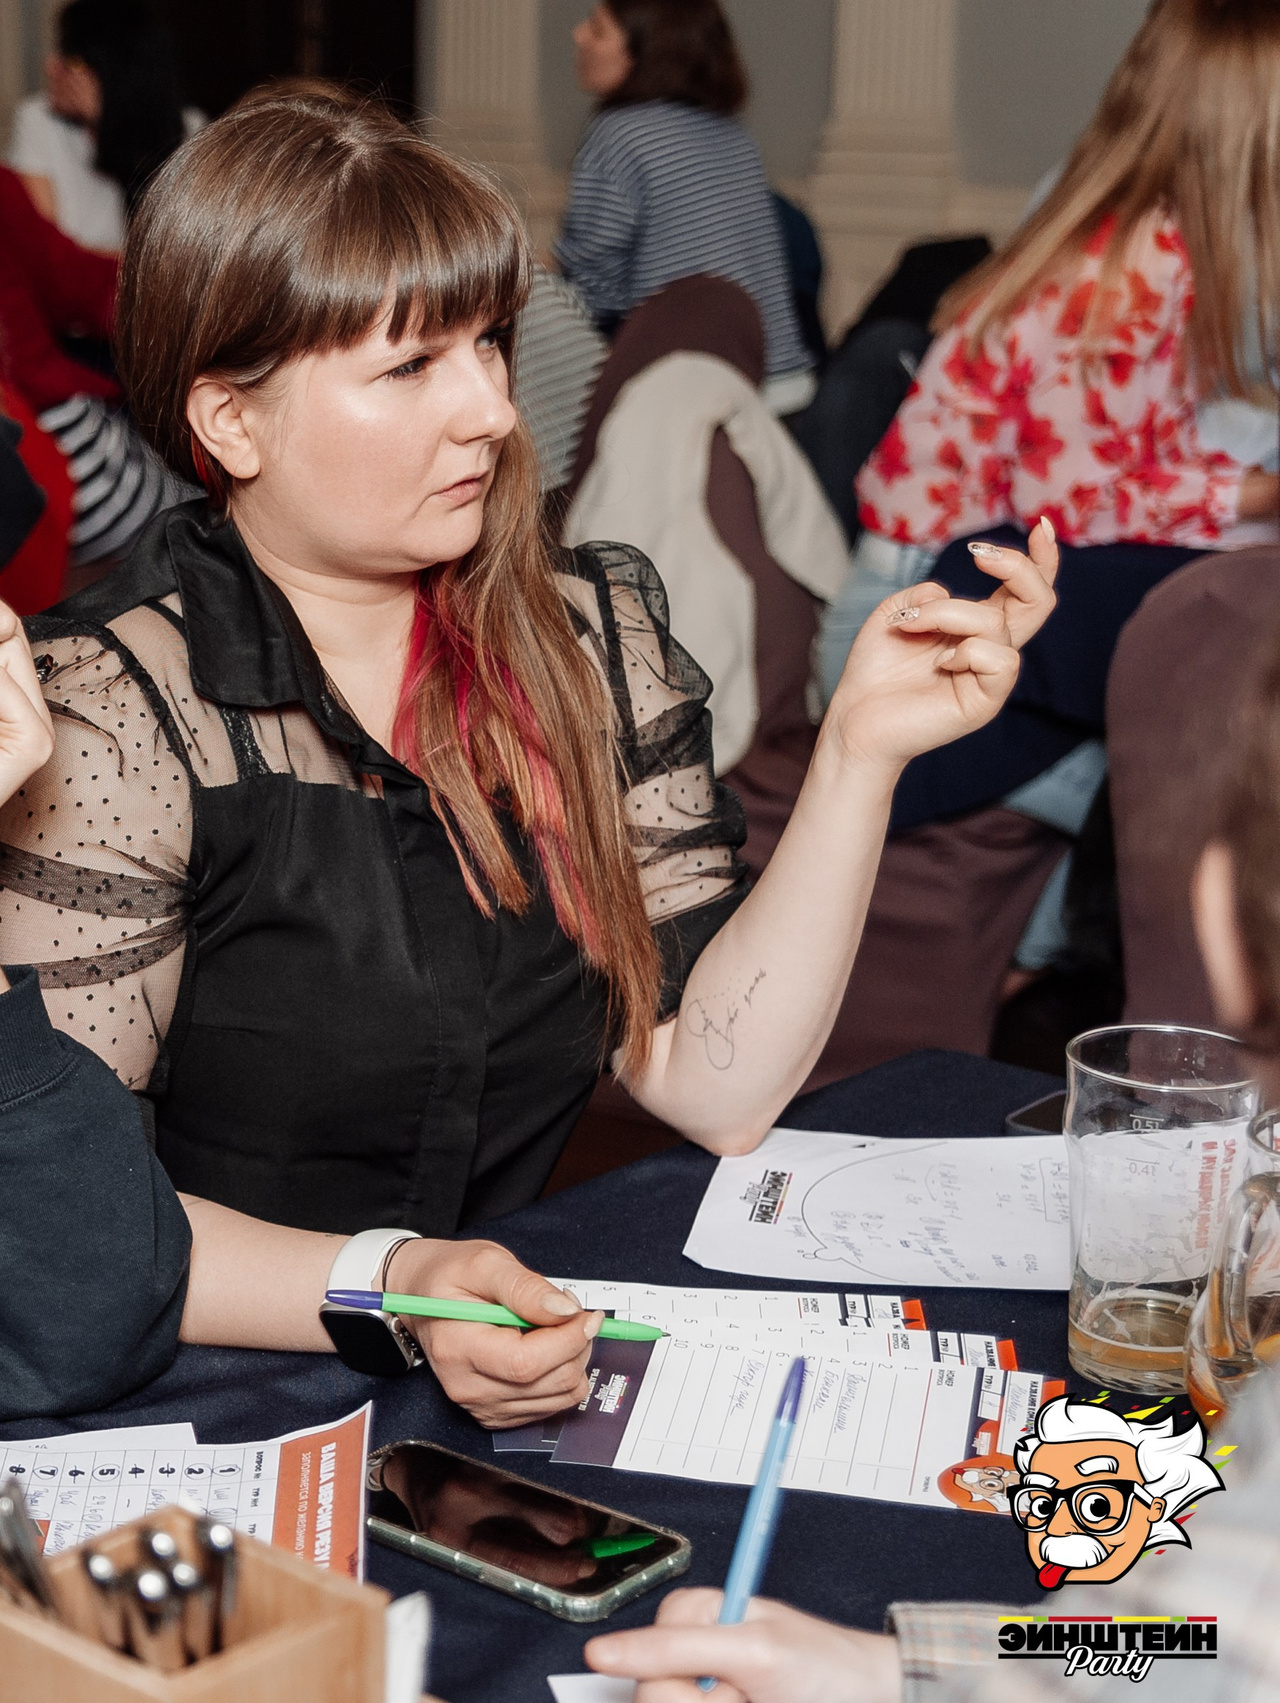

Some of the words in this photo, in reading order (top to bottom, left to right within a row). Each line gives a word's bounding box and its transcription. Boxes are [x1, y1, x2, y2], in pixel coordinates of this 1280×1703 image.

[810, 1298, 820, 1313] НОМЕР
[673, 1339, 689, 1349] 10
[900, 1333, 910, 1350] НОМЕР
[940, 1338, 949, 1348] ТУР
[936, 1369, 945, 1386] ВОПРОСА
[944, 1370, 956, 1387] НОМЕР
[984, 1374, 993, 1385] ТУР
[1028, 1381, 1039, 1407] НАЗВАНИЕ
[255, 1451, 264, 1472] ВОПРОС
[319, 1441, 337, 1485] ВАША
[8, 1465, 26, 1474] 8
[39, 1468, 56, 1476] 7
[68, 1469, 85, 1477] 6
[128, 1466, 145, 1475] 4
[158, 1466, 176, 1475] 3
[187, 1467, 204, 1475] 2
[299, 1451, 312, 1501] заполняется
[251, 1487, 260, 1498] ТУР
[298, 1500, 308, 1512] по
[316, 1481, 335, 1532] ВЕРСИЯ
[248, 1523, 257, 1534] ТУР
[294, 1512, 307, 1551] желанию
